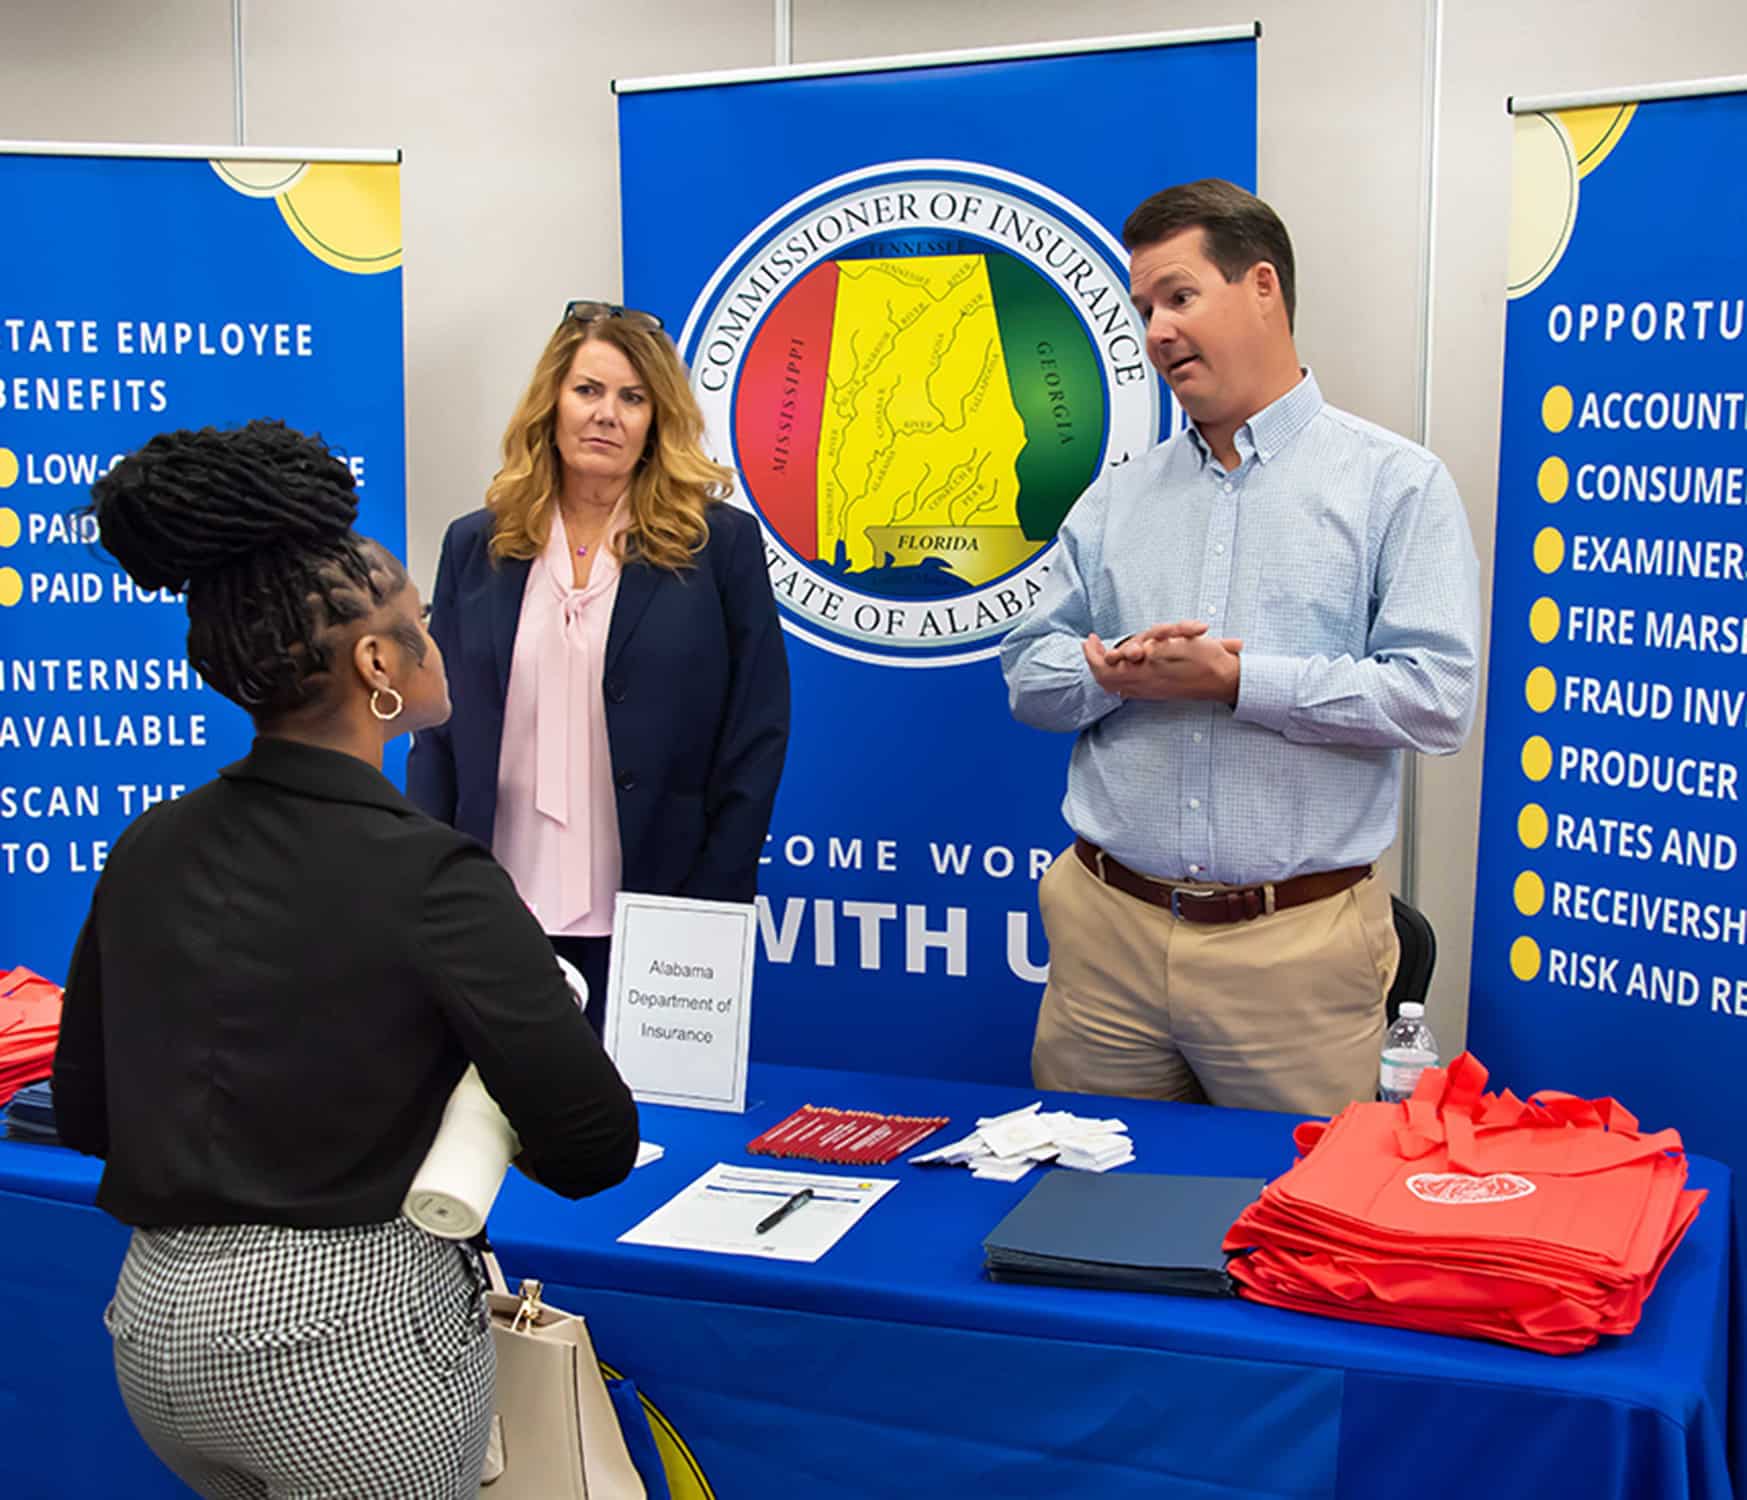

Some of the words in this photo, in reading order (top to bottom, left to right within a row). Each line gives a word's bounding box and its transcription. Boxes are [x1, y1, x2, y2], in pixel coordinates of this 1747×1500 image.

[700, 193, 920, 391] COMMISSIONER
[930, 191, 982, 223] OF
[987, 204, 1145, 386] INSURANCE
[0, 319, 98, 353] TATE
[117, 321, 313, 357] EMPLOYEE
[1548, 299, 1744, 343] OPPORTU
[772, 338, 805, 475] MISSISSIPPI
[1036, 341, 1074, 446] GEORGIA
[1578, 392, 1747, 431] ACCOUNT
[1576, 463, 1747, 505] CONSUME
[29, 513, 100, 544] PAID
[897, 534, 979, 552] FLORIDA
[1572, 535, 1747, 581] EXAMINER
[30, 572, 103, 603] PAID
[763, 543, 844, 622] TATE
[854, 605, 906, 637] OF
[919, 565, 1051, 638] ALABA
[1568, 606, 1635, 646] FIRE
[1564, 676, 1673, 720] FRAUD
[1683, 686, 1747, 728] INV
[0, 715, 206, 748] AVAILABLE
[1560, 746, 1738, 801] PRODUCER
[1, 785, 99, 818] SCAN
[1, 842, 50, 874] TO
[758, 834, 897, 871] OME
[1556, 814, 1653, 860] RATES
[1661, 828, 1737, 872] AND
[649, 960, 714, 980] Alabama
[1549, 949, 1619, 994] RISK
[1626, 963, 1700, 1007] AND
[628, 989, 713, 1012] Department
[716, 998, 733, 1013] of
[641, 1022, 713, 1044] Insurance
